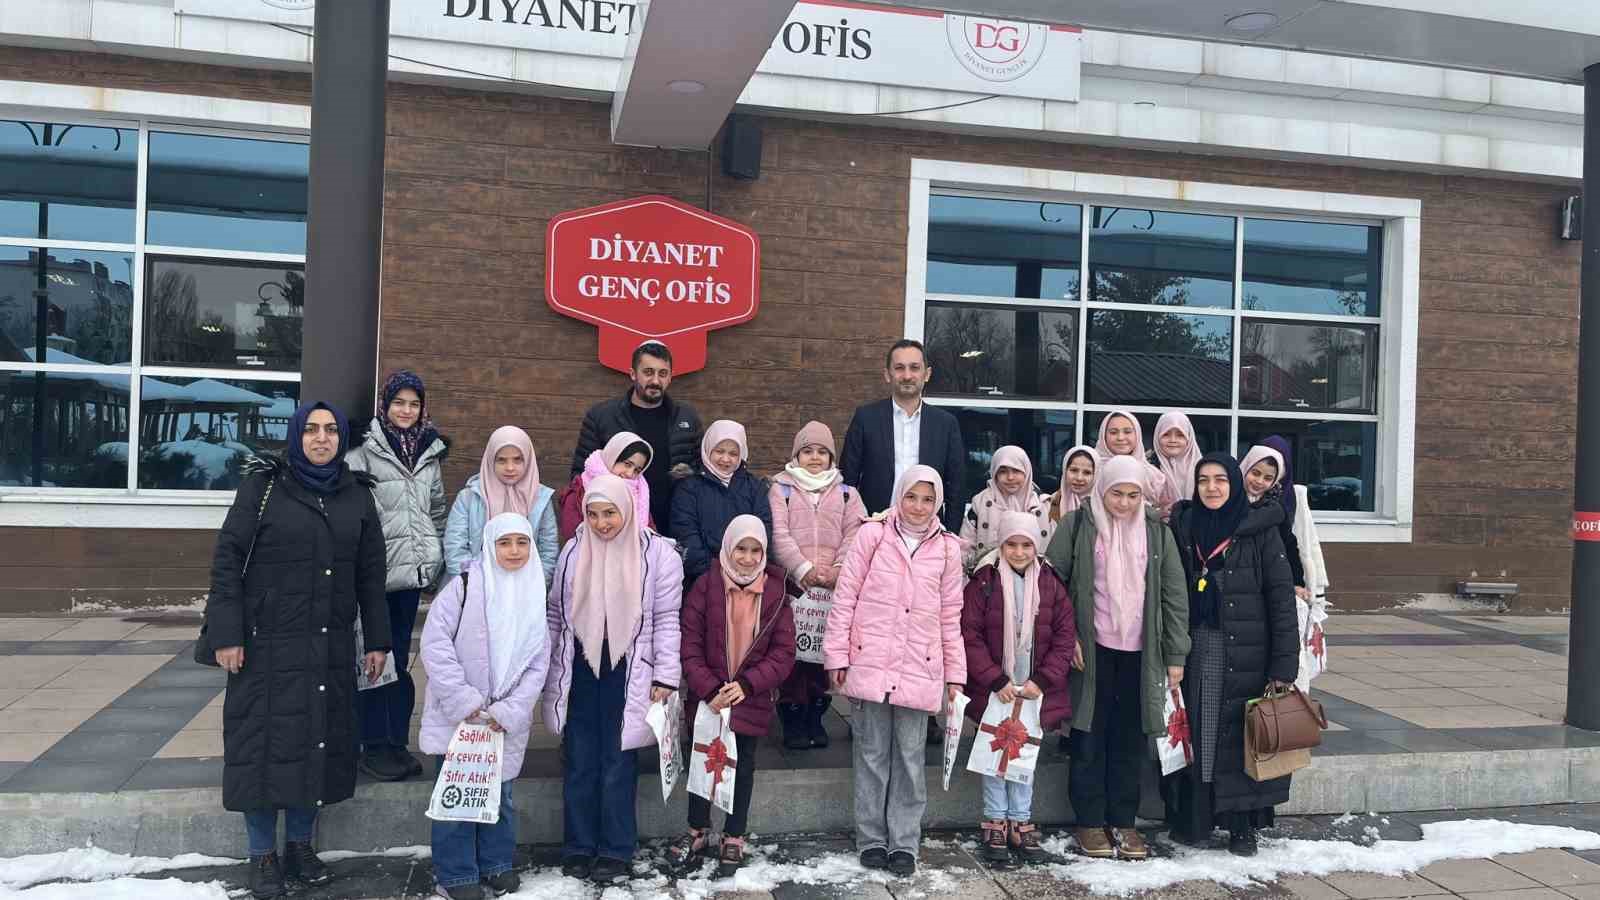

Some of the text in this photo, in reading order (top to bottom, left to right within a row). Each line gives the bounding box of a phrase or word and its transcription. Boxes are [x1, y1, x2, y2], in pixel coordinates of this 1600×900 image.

[782, 18, 872, 60] OFİS
[975, 23, 1019, 51] DG
[589, 232, 725, 268] DİYANET
[577, 274, 731, 307] GENÇ OFİS
[459, 730, 492, 744] Sağlıklı
[456, 752, 482, 764] çevre
[463, 787, 490, 797] SIFIR
[462, 798, 487, 808] ATIK
